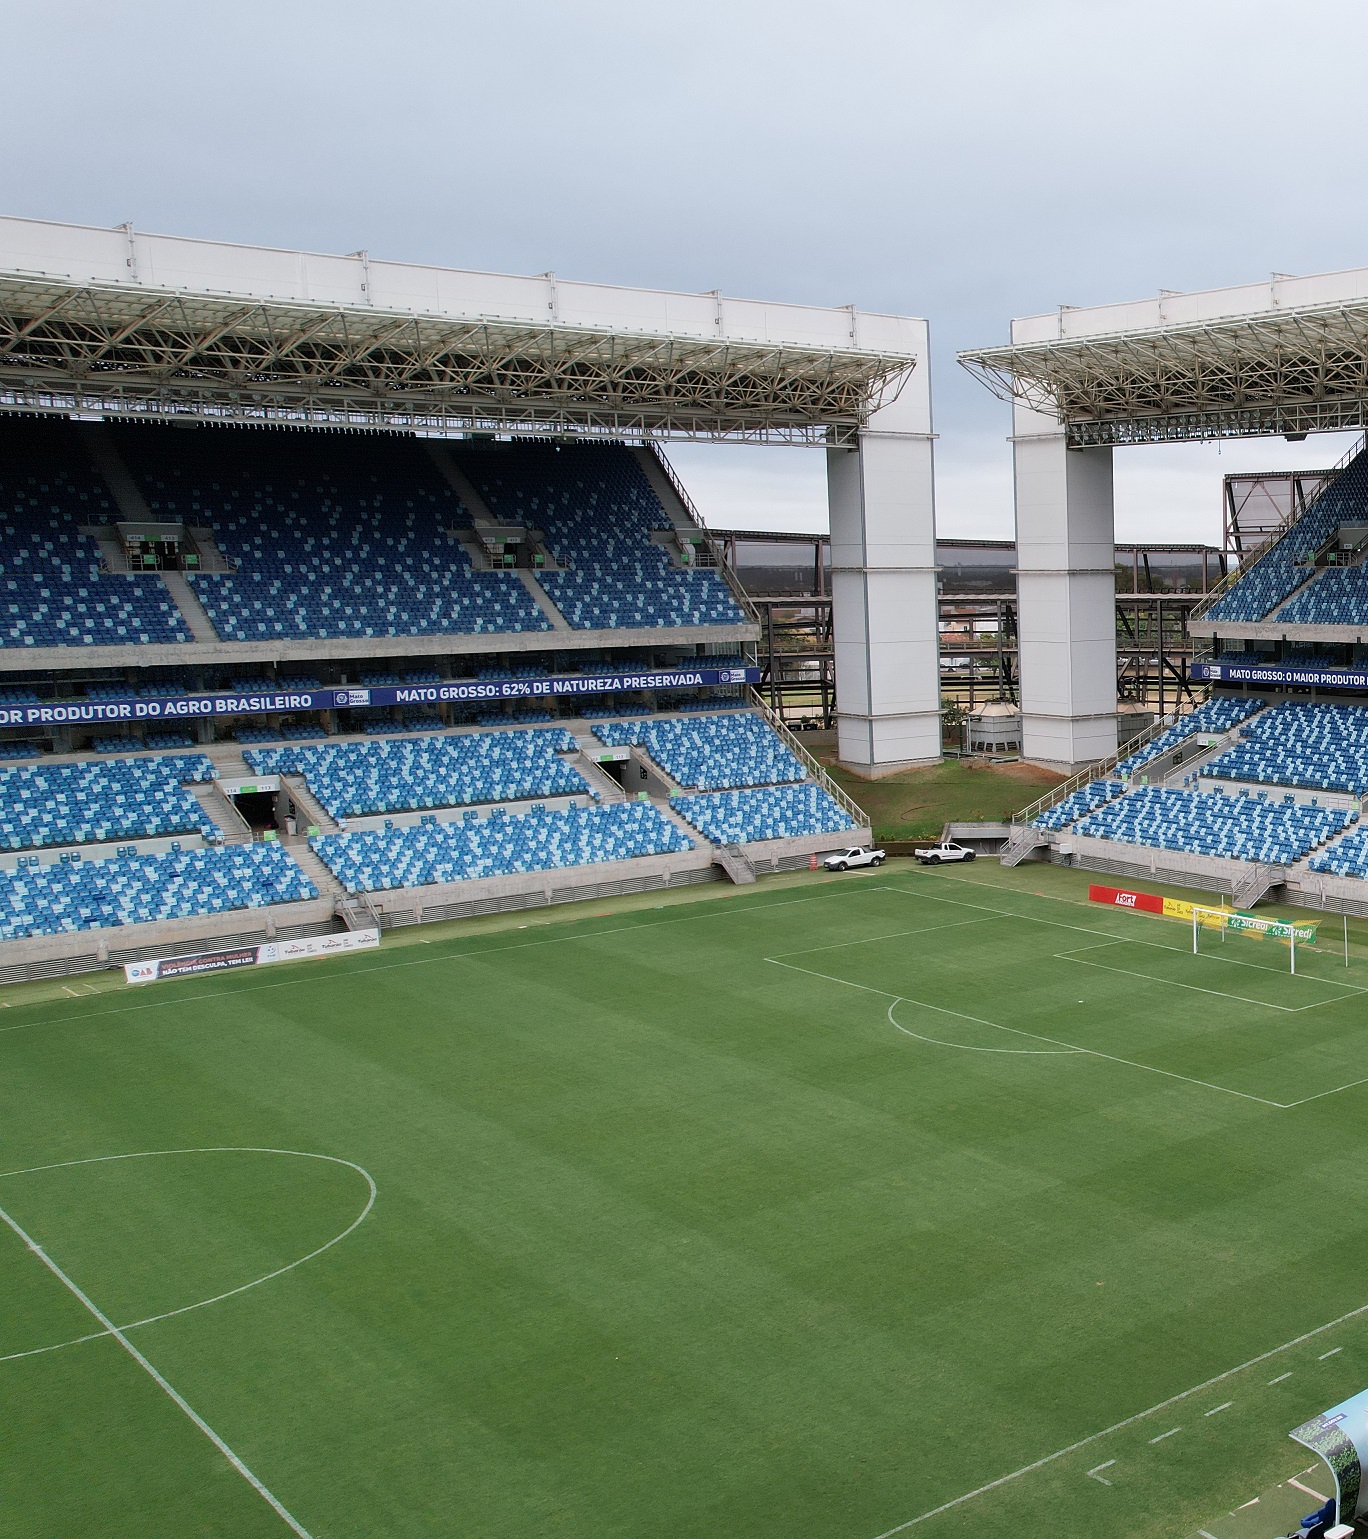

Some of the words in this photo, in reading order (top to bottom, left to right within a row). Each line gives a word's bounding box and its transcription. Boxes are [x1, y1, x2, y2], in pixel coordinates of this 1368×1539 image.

[396, 688, 437, 702] MATO
[439, 684, 500, 700] GROSSO:
[502, 682, 531, 696] 62%
[533, 681, 551, 694] DE
[553, 678, 622, 693] NATUREZA
[623, 673, 703, 689] PRESERVADA
[1229, 668, 1251, 680] MATO
[1252, 670, 1285, 681] GROSSO:
[1286, 671, 1292, 682] O
[1293, 672, 1320, 684] MAIOR
[1320, 674, 1366, 686] PRODUTOR
[27, 704, 132, 722] PRODUTOR
[135, 702, 161, 717] DO
[164, 700, 212, 716] AGRO
[215, 694, 312, 712] BRASILEIRO
[179, 965, 192, 973] TEM
[227, 958, 241, 966] TEM
